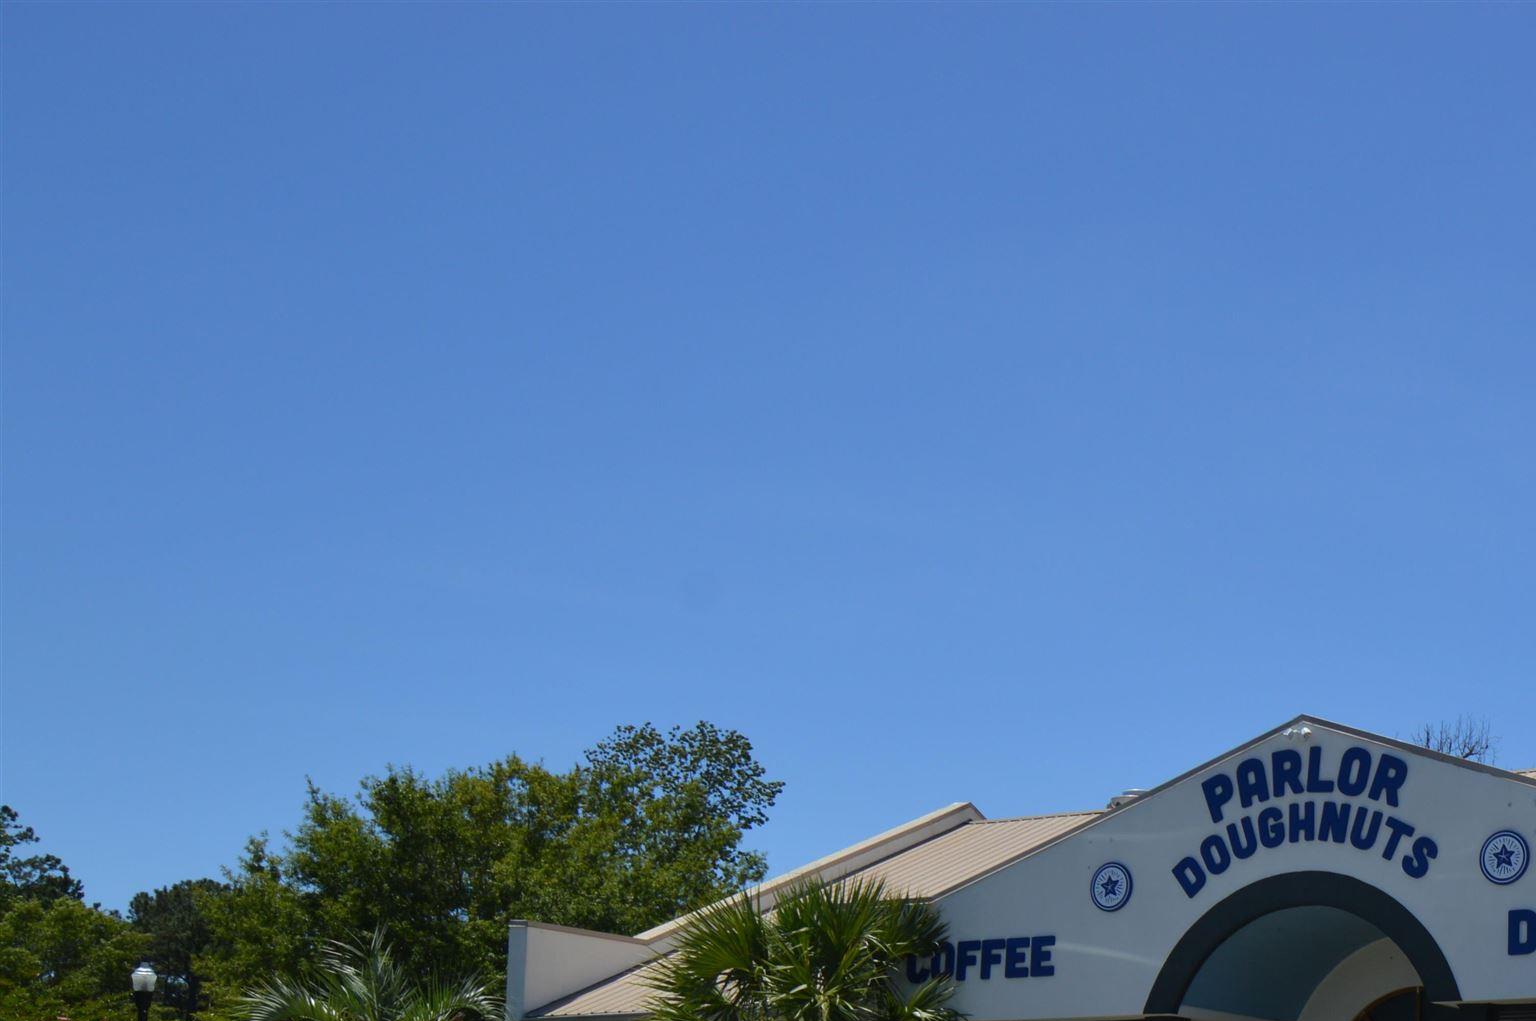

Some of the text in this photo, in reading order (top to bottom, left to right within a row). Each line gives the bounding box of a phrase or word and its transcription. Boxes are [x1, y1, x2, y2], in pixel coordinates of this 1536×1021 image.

[1201, 745, 1409, 824] PARLOR
[1171, 801, 1439, 899] DOUGHNUTS
[906, 935, 1056, 985] COFFEE
